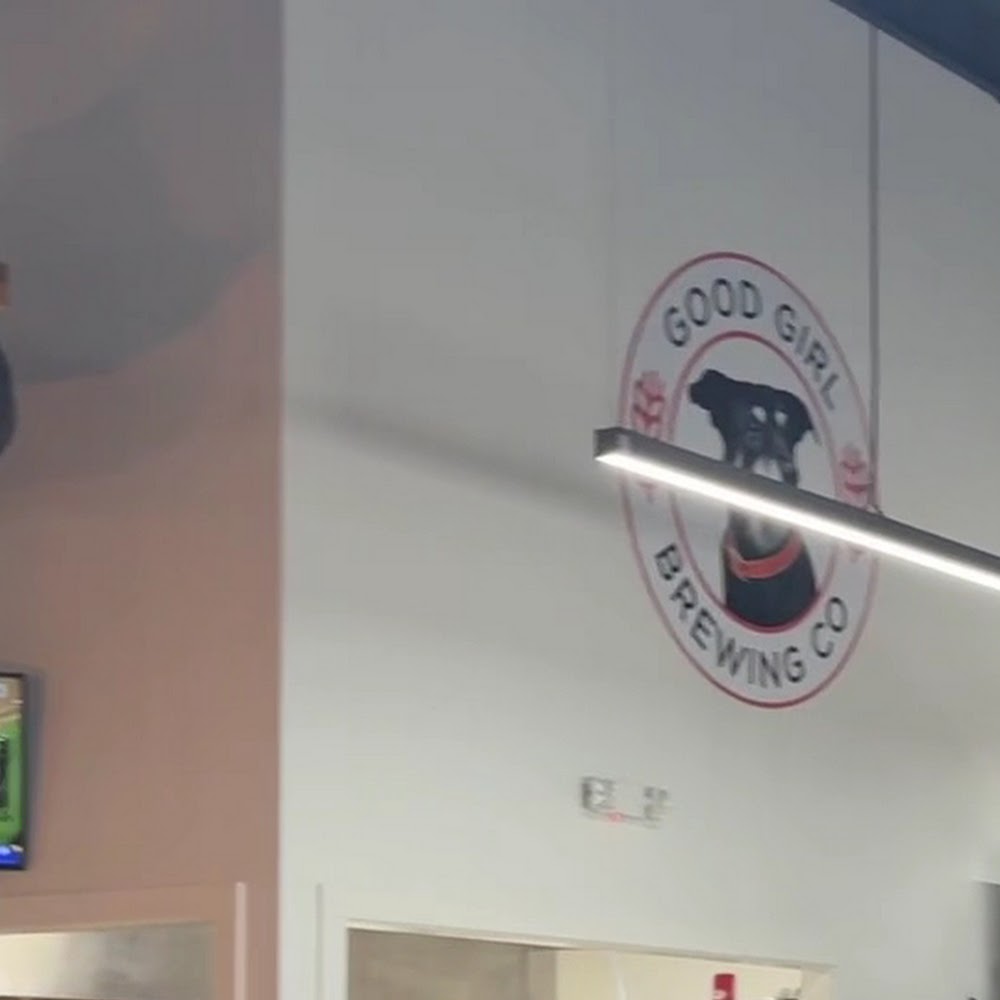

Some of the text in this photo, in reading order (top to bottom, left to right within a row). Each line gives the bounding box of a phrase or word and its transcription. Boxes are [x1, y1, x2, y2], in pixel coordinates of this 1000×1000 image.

[664, 278, 839, 410] GOOD GIRL
[654, 543, 848, 688] BREWING CO
